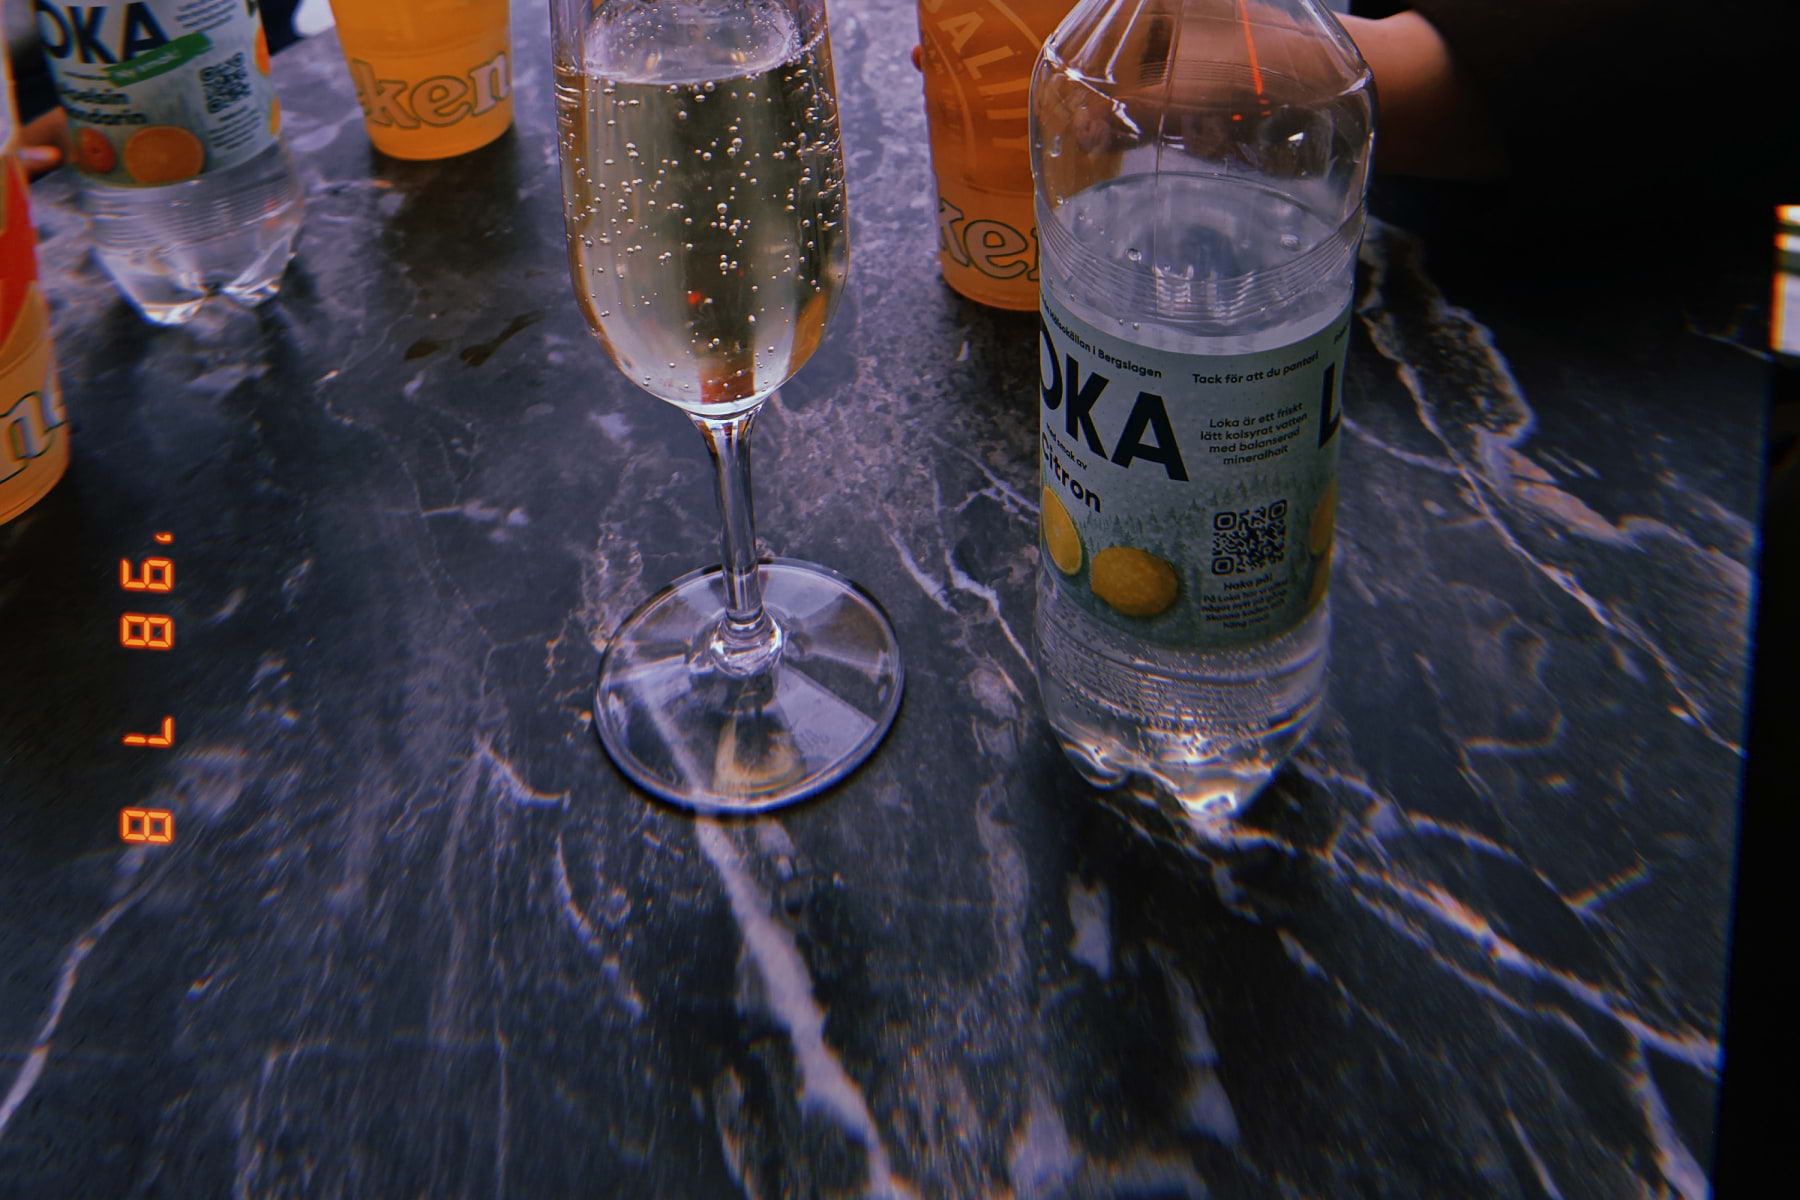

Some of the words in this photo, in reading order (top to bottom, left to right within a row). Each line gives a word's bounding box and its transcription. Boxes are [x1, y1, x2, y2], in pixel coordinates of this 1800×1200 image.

[1097, 348, 1163, 379] Bergslagen
[1192, 373, 1223, 385] Tack
[1225, 373, 1244, 385] för
[1246, 370, 1264, 383] att
[1266, 366, 1281, 378] du
[1200, 430, 1223, 441] lätt
[1225, 424, 1273, 441] kolsyrat
[1275, 411, 1308, 432] vatten
[1209, 418, 1240, 429] Loka
[1242, 415, 1256, 427] är
[1258, 412, 1275, 424] ett
[1209, 442, 1237, 453] med
[1041, 431, 1101, 514] Citron
[1076, 458, 1089, 471] av
